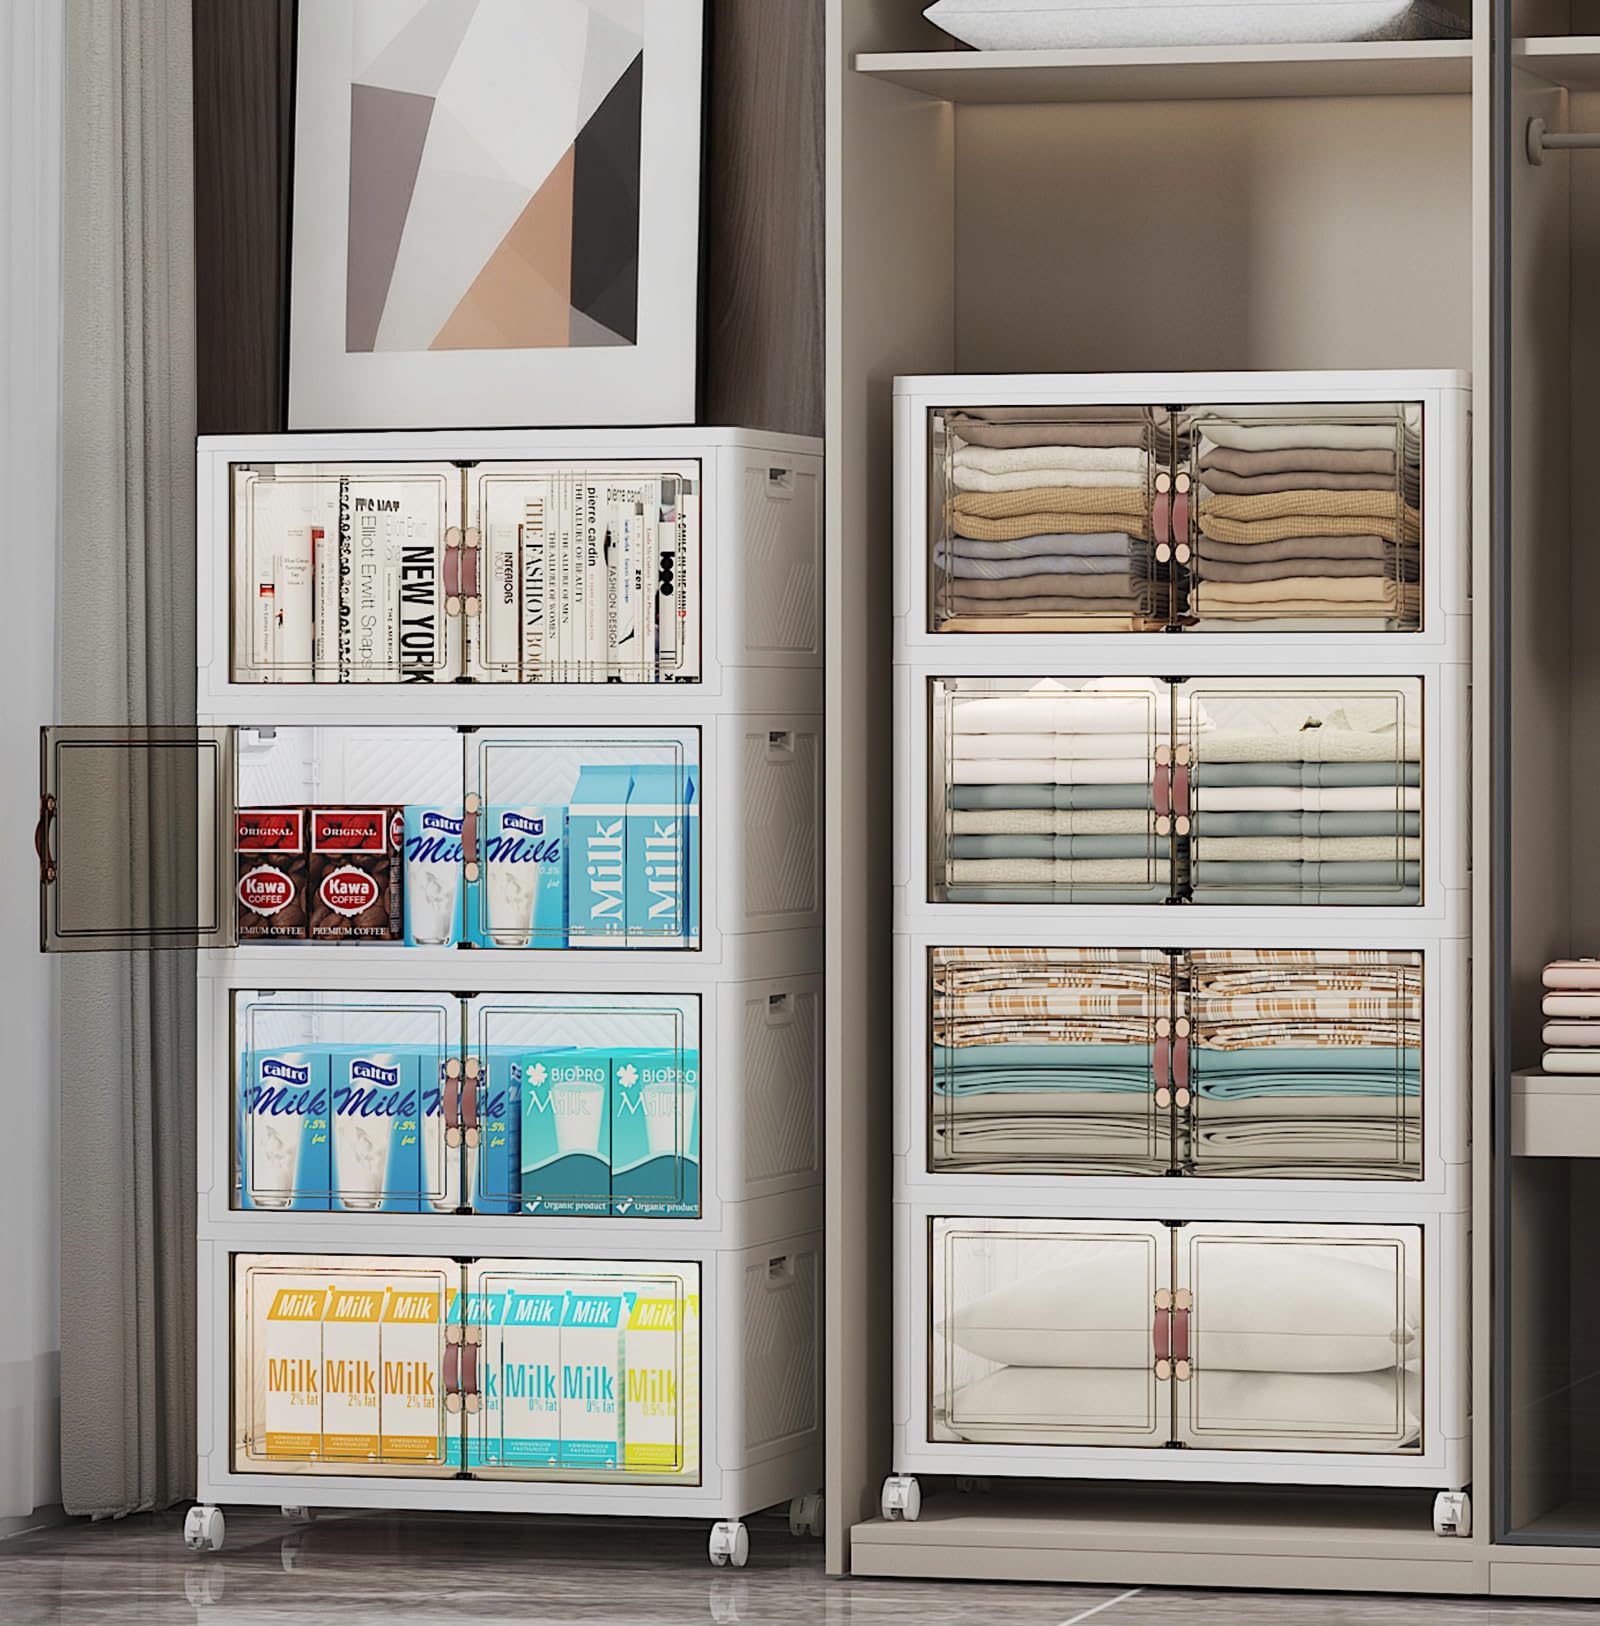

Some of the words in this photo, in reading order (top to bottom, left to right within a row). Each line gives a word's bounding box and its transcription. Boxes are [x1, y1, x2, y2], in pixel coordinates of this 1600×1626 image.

[587, 487, 597, 524] pierre
[526, 498, 543, 538] THE
[361, 515, 376, 558] Elliott
[588, 528, 598, 566] cardin
[575, 547, 582, 561] OF
[361, 564, 376, 609] Erwitt
[402, 547, 434, 605] NEW
[504, 552, 513, 604] INTERIORS
[526, 543, 543, 626] FASHION
[609, 566, 618, 609] FASHION
[549, 589, 556, 600] OF
[562, 589, 569, 600] OF
[609, 612, 618, 648] DESIGN
[359, 615, 376, 669] Snaps
[401, 615, 434, 683] YORK
[526, 632, 543, 683] BOOK
[240, 827, 293, 836] ORIGINAL
[322, 827, 377, 836] ORIGINAL
[406, 836, 465, 863] Mil
[486, 836, 560, 863] Milk
[587, 818, 623, 921] Milk
[645, 818, 681, 921] Milk
[246, 878, 286, 893] Kawa
[329, 879, 369, 894] Kawa
[547, 880, 560, 888] fat
[248, 895, 283, 904] COFFEE
[331, 895, 366, 905] COFFEE
[270, 927, 303, 936] COFFEE
[313, 927, 352, 935] PREMIUM
[353, 927, 386, 936] COFFEE
[551, 1066, 605, 1082] BIOPRO
[642, 1067, 697, 1083] BIOPRO
[244, 1087, 327, 1116] Milk
[334, 1088, 416, 1117] Milk
[303, 1120, 326, 1129] 1.5%
[393, 1121, 416, 1130] 1.5%
[312, 1134, 326, 1144] fat
[401, 1136, 416, 1146] fat
[491, 1136, 505, 1147] fat
[544, 1201, 574, 1210] Organic
[575, 1202, 606, 1211] product
[635, 1202, 665, 1212] Organic
[667, 1203, 698, 1212] product
[278, 1294, 317, 1317] Milk
[335, 1295, 374, 1318] Milk
[393, 1296, 432, 1319] Milk
[515, 1299, 554, 1322] Milk
[572, 1300, 612, 1323] Milk
[637, 1303, 676, 1327] Milk
[269, 1359, 318, 1392] Milk
[326, 1360, 375, 1394] Milk
[384, 1361, 434, 1395] Milk
[506, 1364, 556, 1398] Milk
[563, 1365, 614, 1399] Milk
[628, 1368, 679, 1403] Milk
[290, 1393, 304, 1406] 2%
[307, 1393, 318, 1406] fat
[348, 1394, 362, 1407] 2%
[364, 1395, 376, 1407] fat
[406, 1395, 421, 1408] 2%
[423, 1396, 435, 1408] fat
[528, 1399, 542, 1411] 0%
[545, 1399, 557, 1411] fat
[586, 1401, 600, 1413] 0%
[602, 1401, 614, 1413] fat
